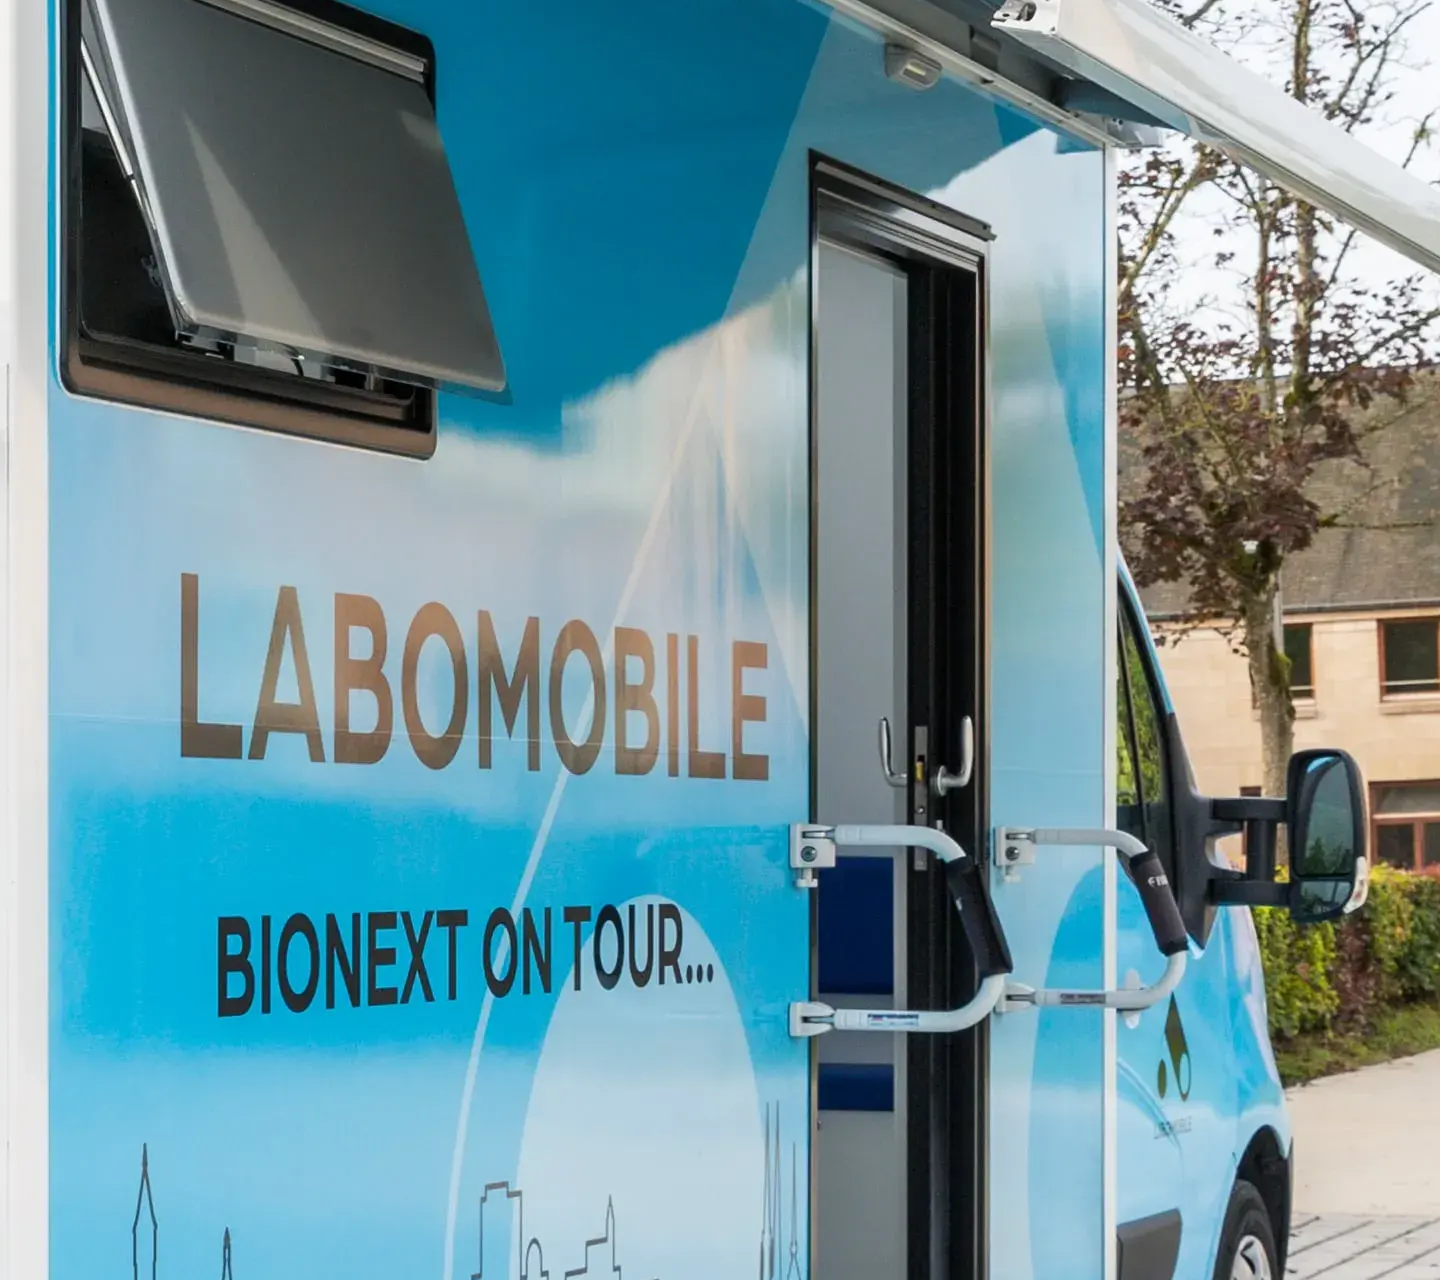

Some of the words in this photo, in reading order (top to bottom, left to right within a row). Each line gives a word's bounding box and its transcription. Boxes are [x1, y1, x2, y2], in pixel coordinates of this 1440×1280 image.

[180, 572, 770, 781] LABOMOBILE
[217, 909, 468, 1017] BIONEXT
[482, 906, 553, 998] ON
[563, 902, 715, 995] TOUR...
